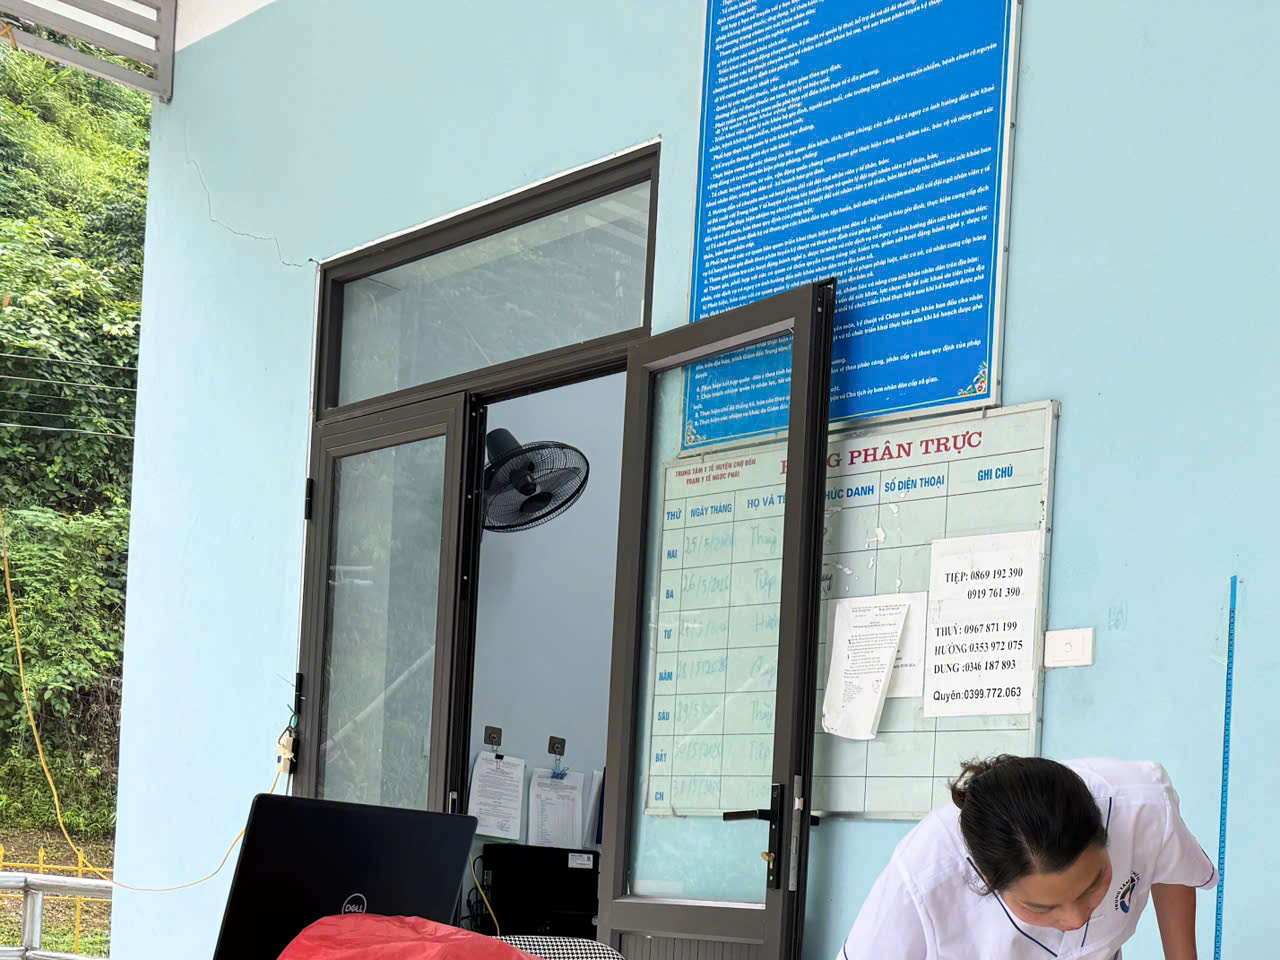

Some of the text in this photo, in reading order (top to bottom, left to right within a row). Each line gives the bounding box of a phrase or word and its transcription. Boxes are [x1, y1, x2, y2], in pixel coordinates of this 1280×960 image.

[848, 440, 913, 465] PHÂN
[920, 431, 983, 454] TRỰC
[977, 463, 1014, 481] GHI CHÚ
[884, 476, 897, 493] SỐ
[919, 474, 945, 490] THOẠI
[824, 484, 875, 501] HỨC DANH
[747, 498, 760, 511] HỌ
[763, 493, 775, 506] VÀ
[690, 502, 732, 518] NGÀY THÁNG
[666, 549, 678, 559] HAI
[945, 567, 1023, 585] TIỆP: 0869 192 390
[665, 590, 674, 599] BA
[967, 586, 1021, 600] 0919 761 390
[963, 624, 984, 635] 0967
[985, 622, 999, 633] 871
[1002, 621, 1017, 632] 199
[969, 642, 989, 653] 0353
[990, 641, 1005, 651] 972
[1007, 639, 1023, 650] 075
[984, 660, 999, 671] 187
[1001, 659, 1016, 670] 893
[345, 904, 363, 913] DELL
